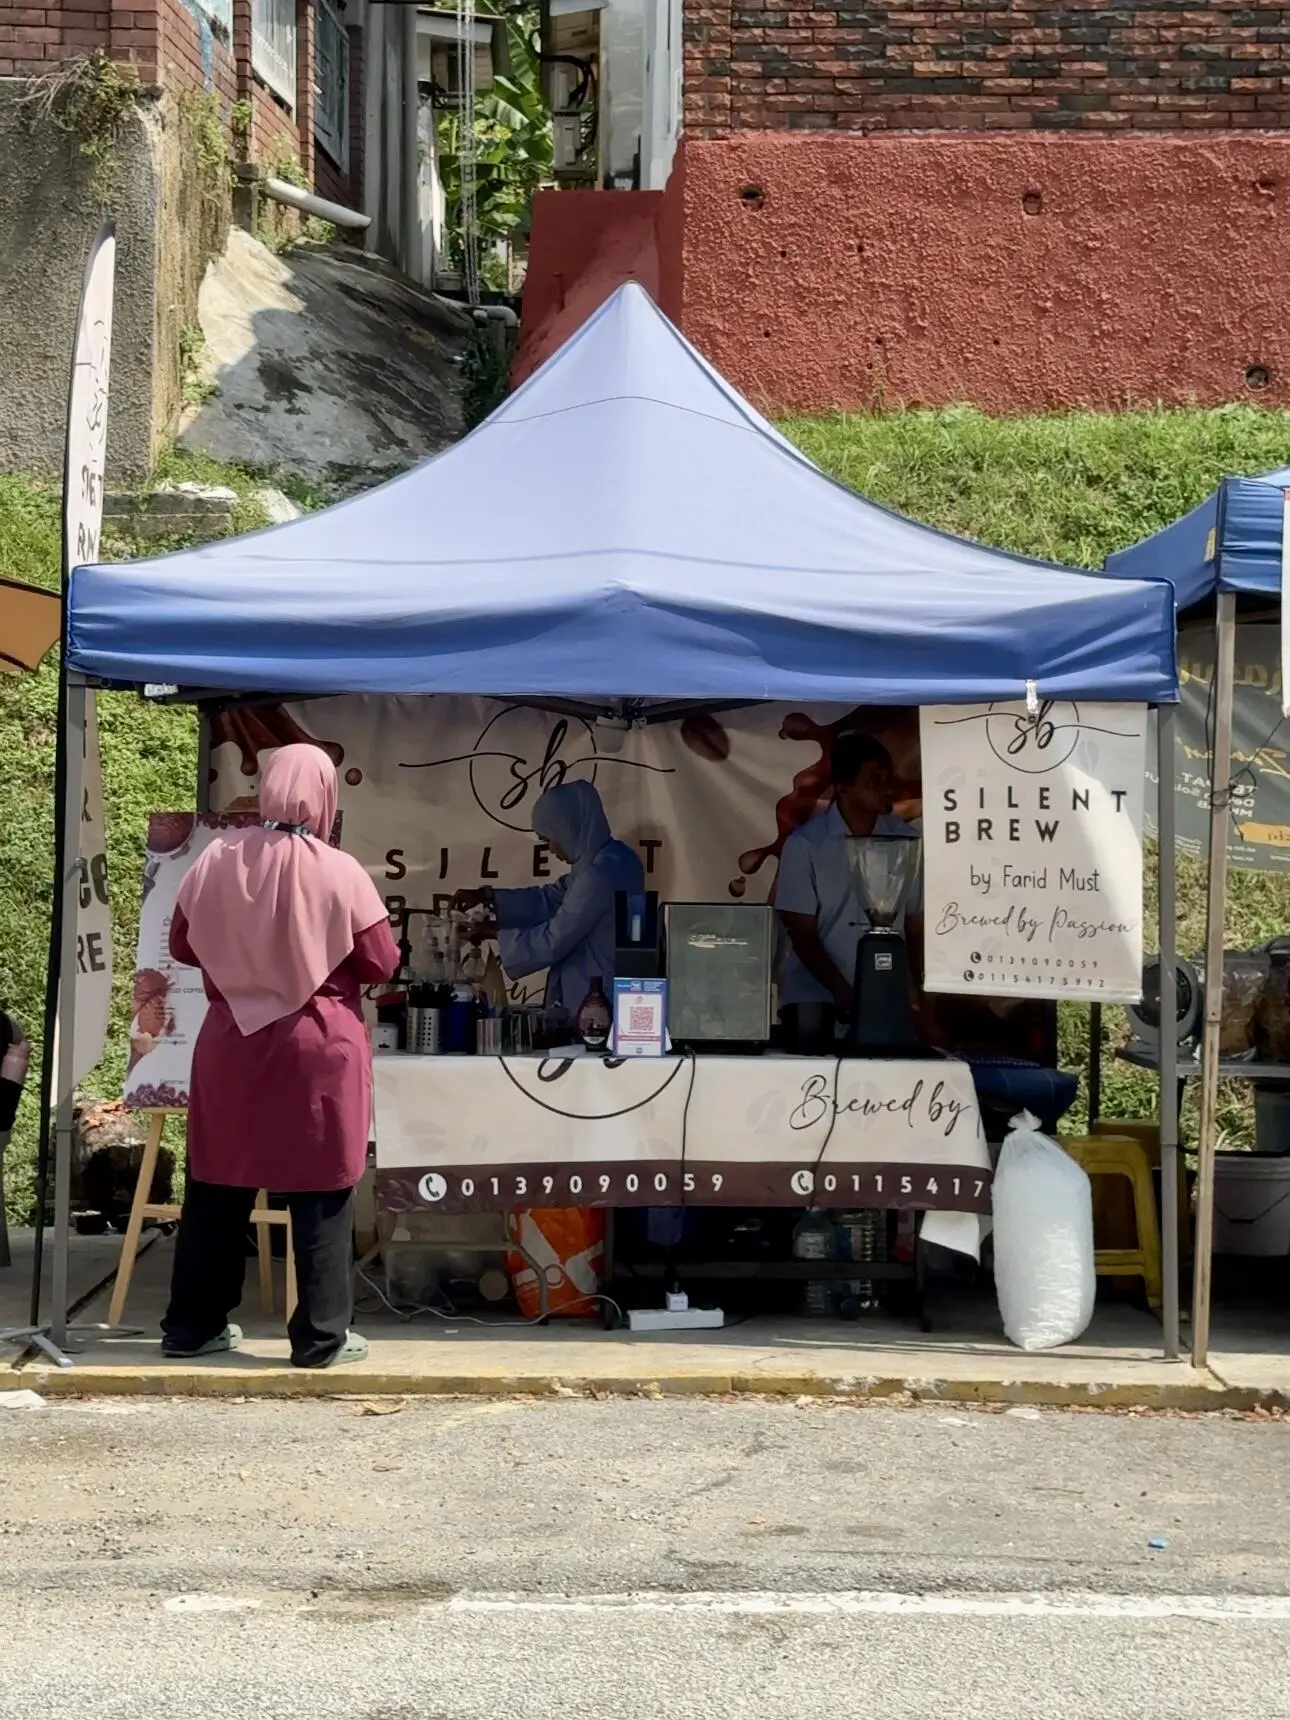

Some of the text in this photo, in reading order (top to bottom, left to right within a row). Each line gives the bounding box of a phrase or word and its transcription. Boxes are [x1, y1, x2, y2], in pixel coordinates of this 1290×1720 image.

[943, 785, 1127, 812] SILENT
[945, 818, 1060, 844] BREW
[384, 839, 663, 881] SILET
[970, 864, 1100, 895] by Farid Must
[935, 901, 1134, 943] Brewed by Passion
[789, 1074, 923, 1130] Brewed
[927, 1081, 971, 1137] by
[460, 1173, 985, 1198] 0139090059 0115417
